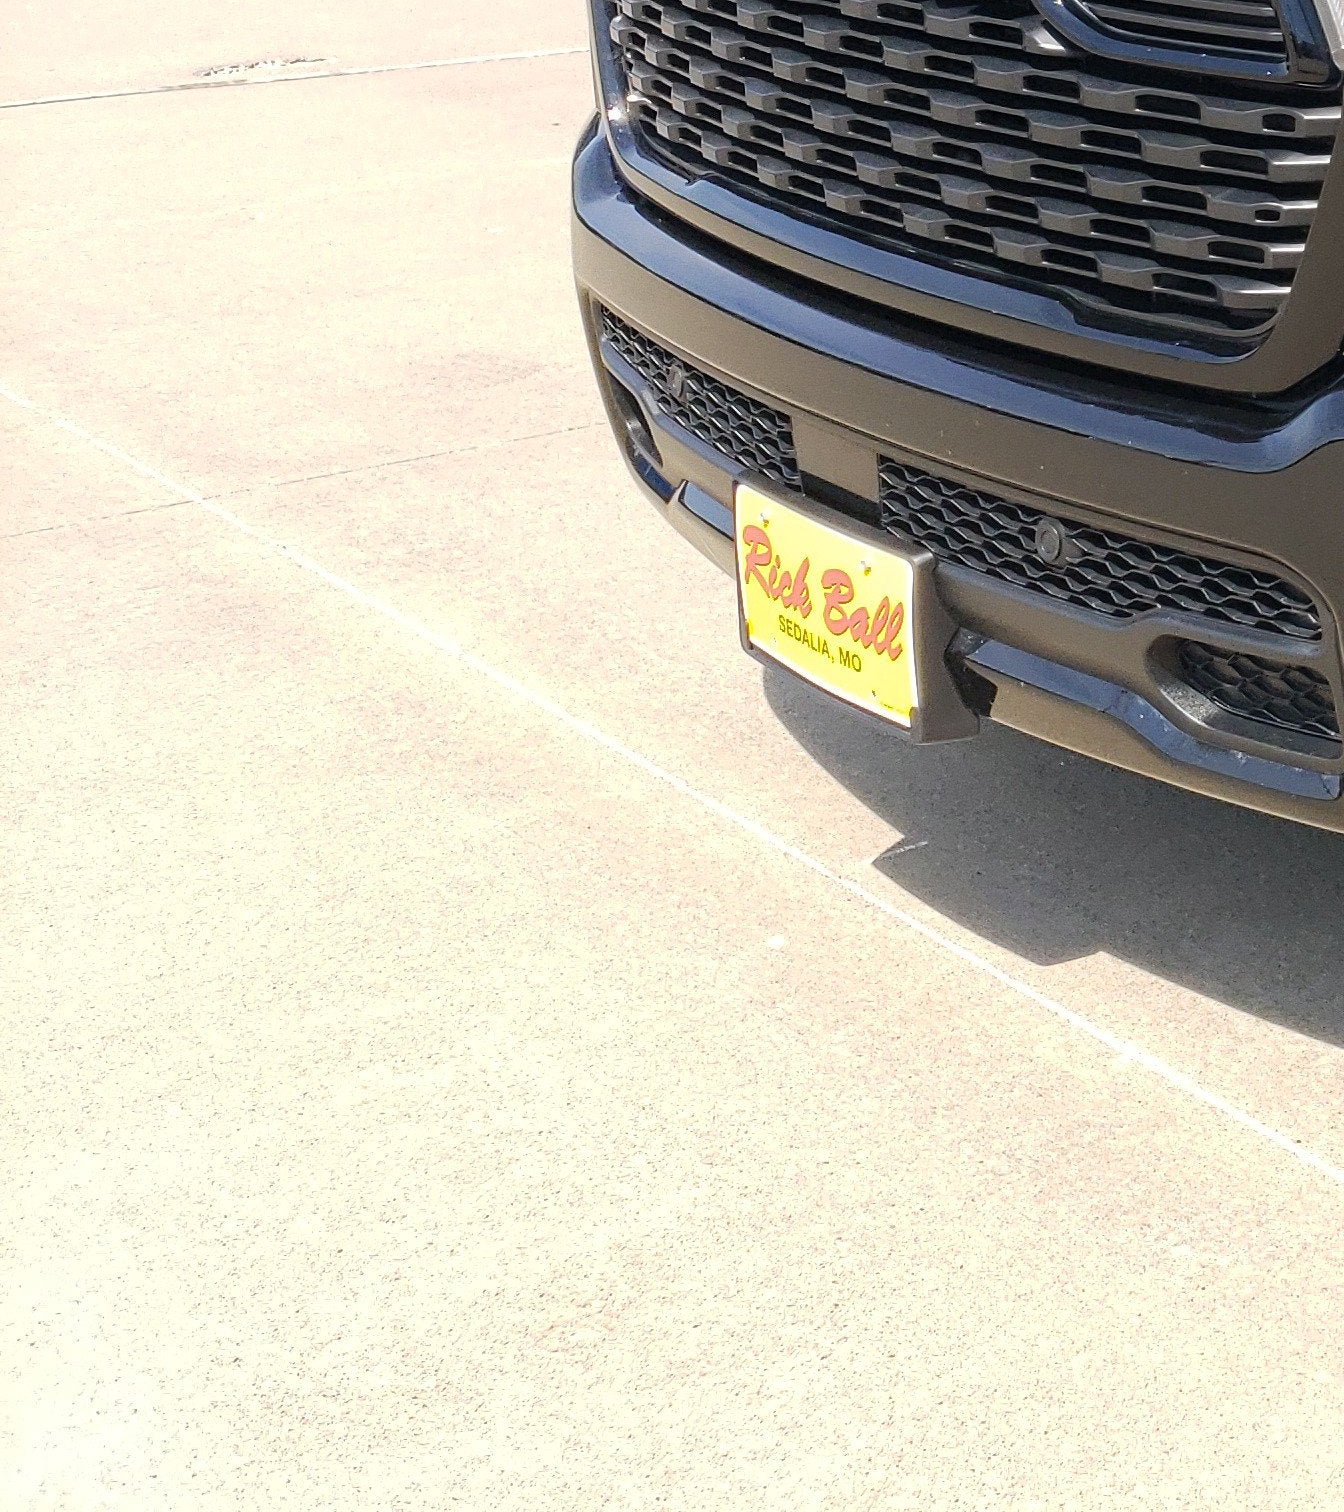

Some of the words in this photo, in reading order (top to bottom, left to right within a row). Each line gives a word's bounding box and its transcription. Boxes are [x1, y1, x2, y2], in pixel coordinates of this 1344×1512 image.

[743, 525, 812, 618] Rick
[821, 569, 904, 661] Ball
[778, 615, 835, 663] SEDALIA,
[839, 647, 862, 673] MO
